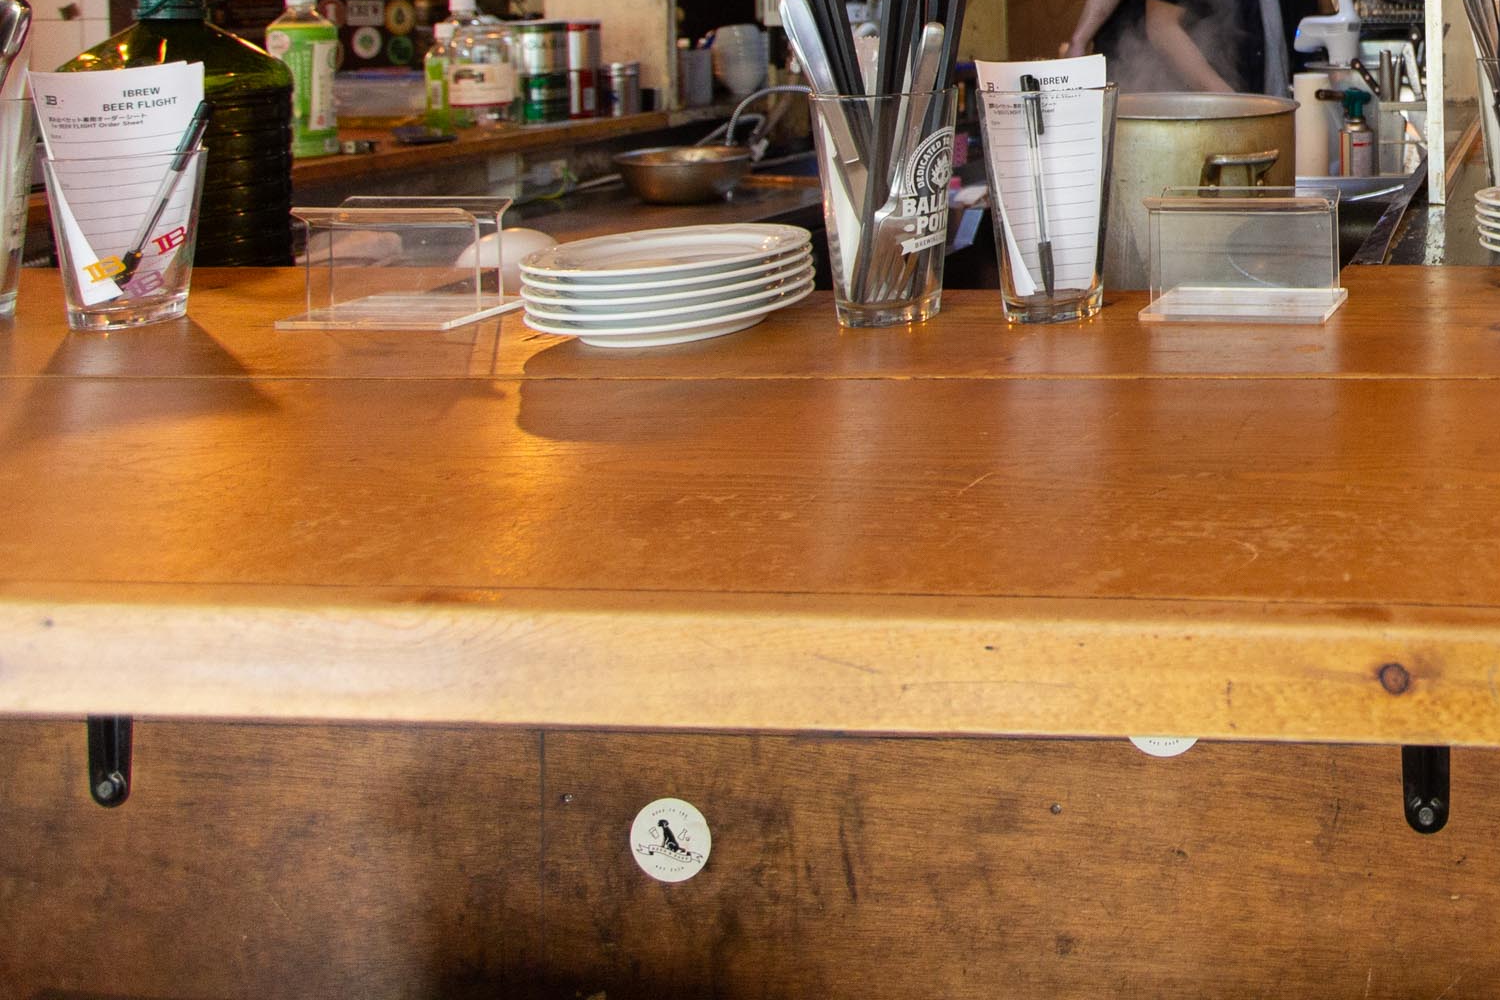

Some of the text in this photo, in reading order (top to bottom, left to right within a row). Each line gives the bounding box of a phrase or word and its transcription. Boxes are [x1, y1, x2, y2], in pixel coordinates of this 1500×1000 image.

[1040, 76, 1069, 85] IBREW
[122, 86, 161, 98] IBREW
[102, 96, 178, 112] BEER FLIGHT
[916, 140, 942, 189] DEDICATED
